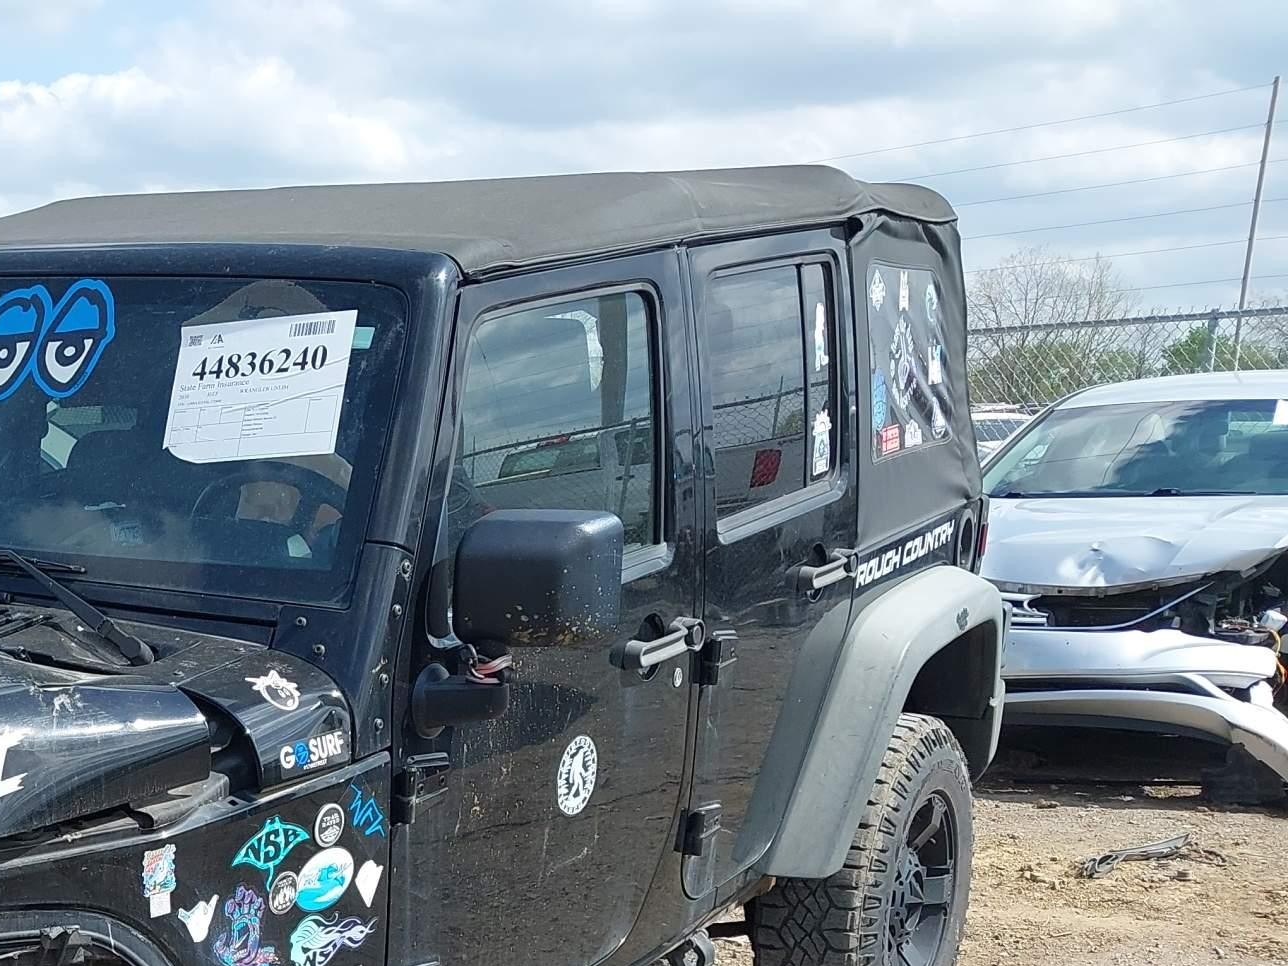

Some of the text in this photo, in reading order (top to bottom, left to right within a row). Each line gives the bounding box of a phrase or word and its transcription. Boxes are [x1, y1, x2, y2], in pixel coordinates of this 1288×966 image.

[192, 345, 328, 381] 44836240
[179, 379, 250, 393] State Farm Insurance
[855, 519, 955, 589] ROUGH COUNTRY
